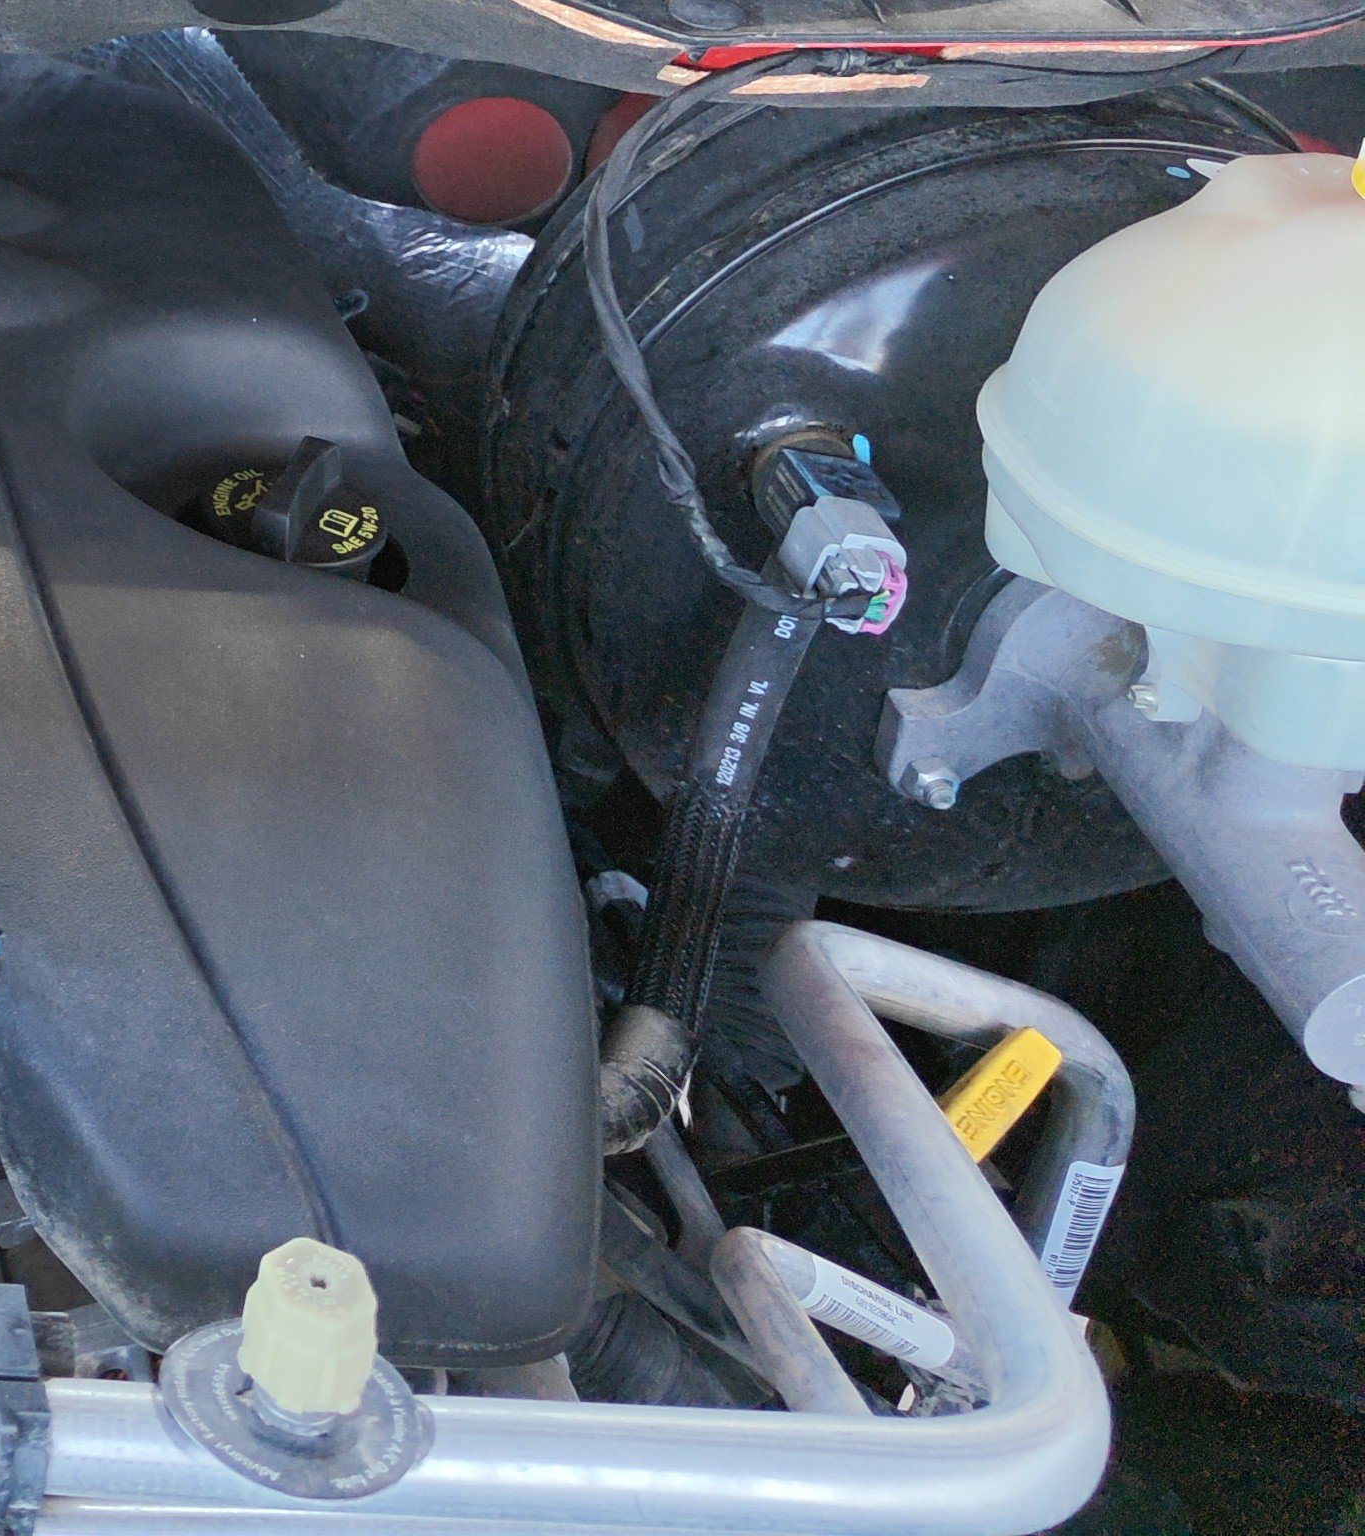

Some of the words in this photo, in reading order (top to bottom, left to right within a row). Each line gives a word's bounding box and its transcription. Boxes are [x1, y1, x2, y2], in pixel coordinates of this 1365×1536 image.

[213, 478, 239, 517] ENGINE
[234, 468, 265, 482] OIL
[331, 536, 366, 556] SAE
[360, 505, 379, 541] 5W-20
[747, 680, 769, 696] VL
[739, 701, 760, 720] IN.
[729, 721, 751, 744] 3/8
[715, 746, 742, 787] 120213
[840, 1275, 892, 1311] DISCHARGE
[894, 1305, 915, 1324] LINE
